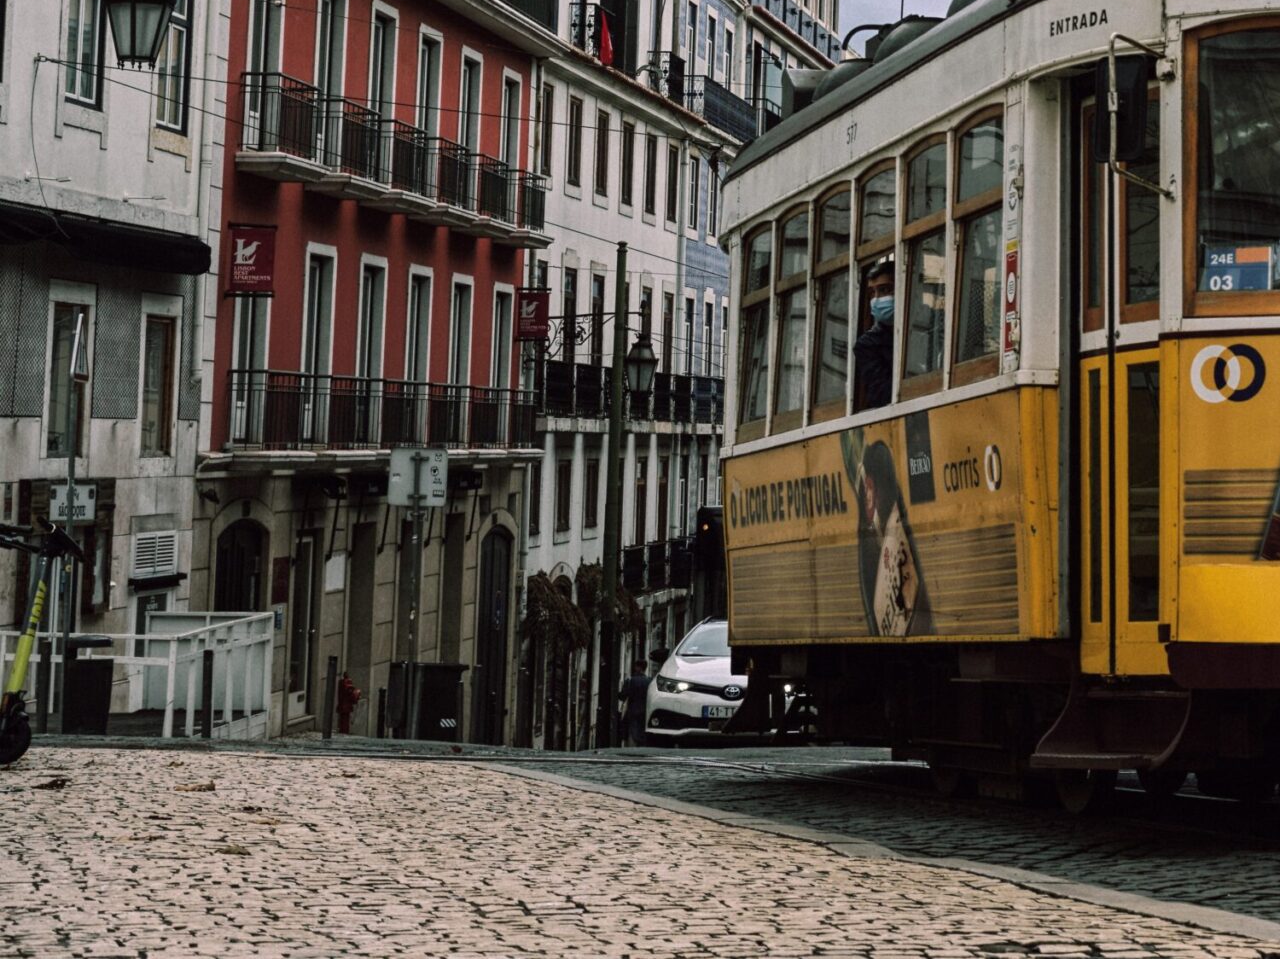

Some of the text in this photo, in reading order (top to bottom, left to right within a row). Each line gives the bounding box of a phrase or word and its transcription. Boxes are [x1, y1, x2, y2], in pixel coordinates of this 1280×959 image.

[1049, 8, 1108, 37] ENTRADA
[846, 122, 858, 145] 577
[1210, 253, 1234, 265] 24E
[1209, 275, 1234, 290] 03
[909, 454, 931, 476] BEIRÃO
[943, 445, 980, 493] carris
[730, 471, 848, 529] O LICOR DE PORTUGAL
